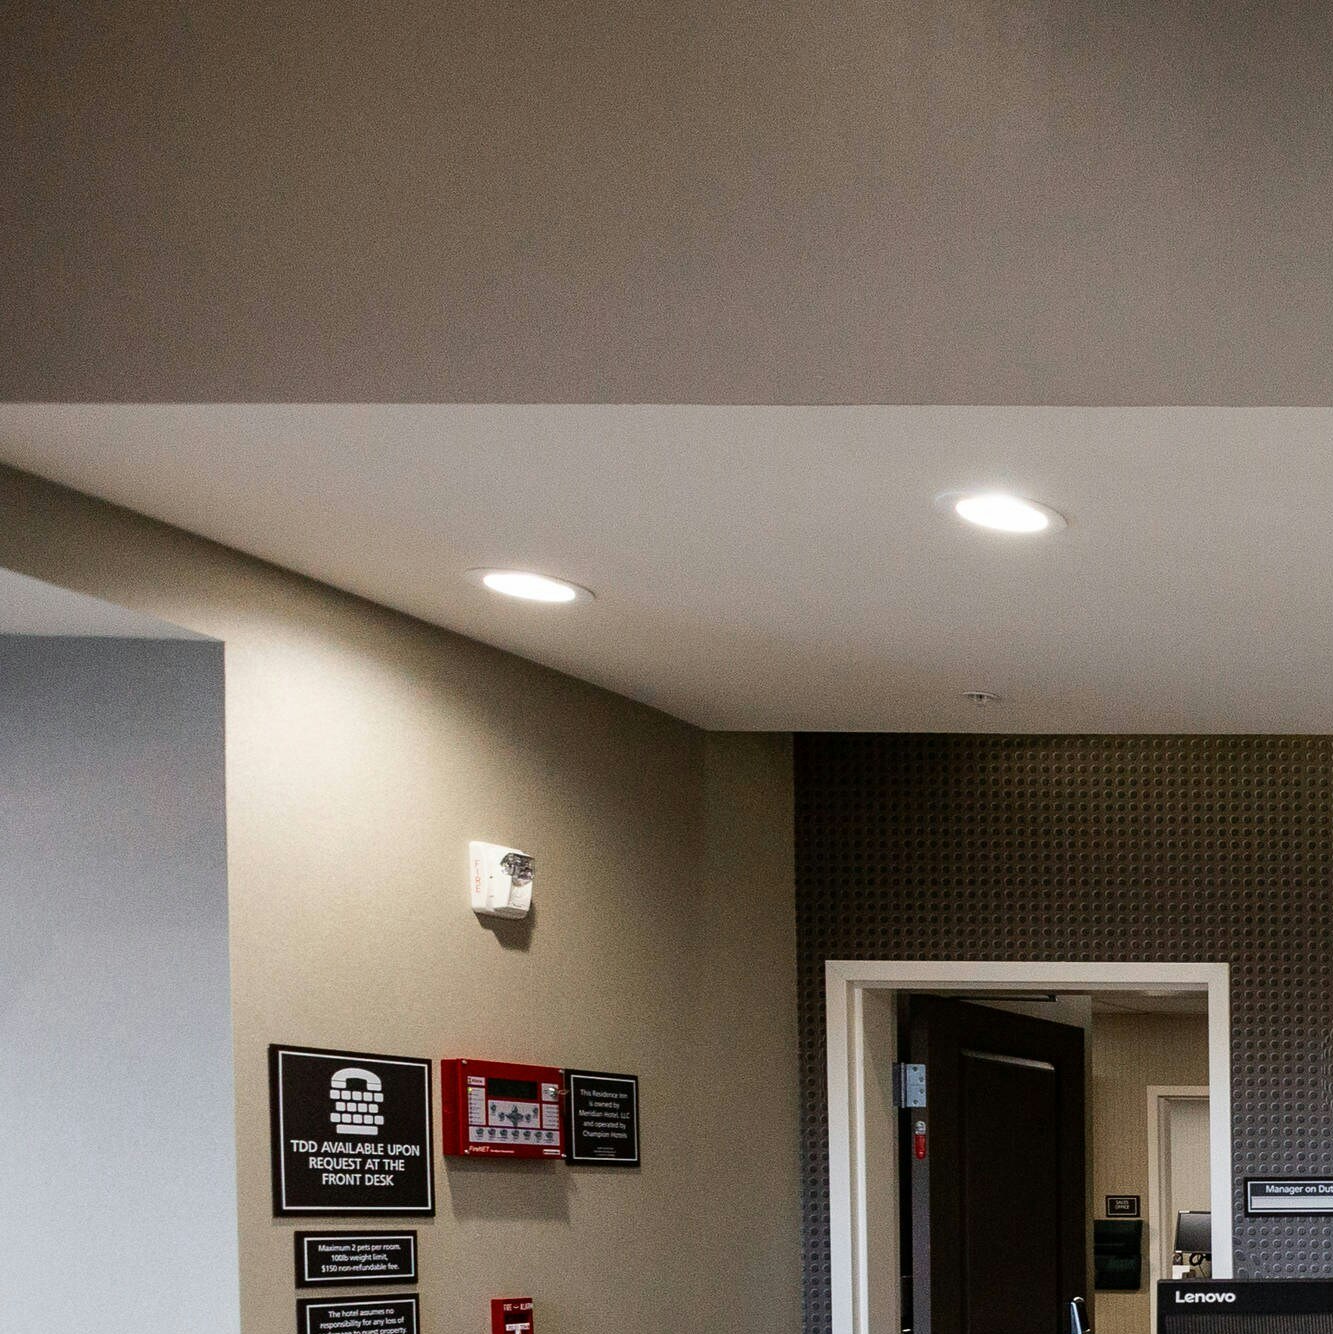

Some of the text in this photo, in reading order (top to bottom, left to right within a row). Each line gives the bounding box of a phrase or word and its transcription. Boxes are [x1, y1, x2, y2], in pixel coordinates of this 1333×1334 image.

[290, 1140, 420, 1156] TDD AVAILABLE UPON
[308, 1156, 405, 1172] REQUEST AT THE
[322, 1173, 395, 1186] FRONT DESK
[1265, 1184, 1303, 1195] Manager
[318, 1244, 351, 1252] Maximum
[357, 1244, 371, 1252] pets
[371, 1244, 382, 1252] per
[350, 1254, 372, 1262] weight
[321, 1262, 400, 1273] $150 non-refundable fee.
[1175, 1290, 1236, 1304] Lenovo
[328, 1310, 341, 1318] The
[342, 1309, 359, 1318] hotel
[360, 1308, 385, 1316] assumes
[320, 1320, 362, 1330] responsibility
[362, 1318, 372, 1326] for
[372, 1318, 384, 1326] any
[397, 1316, 404, 1324] of
